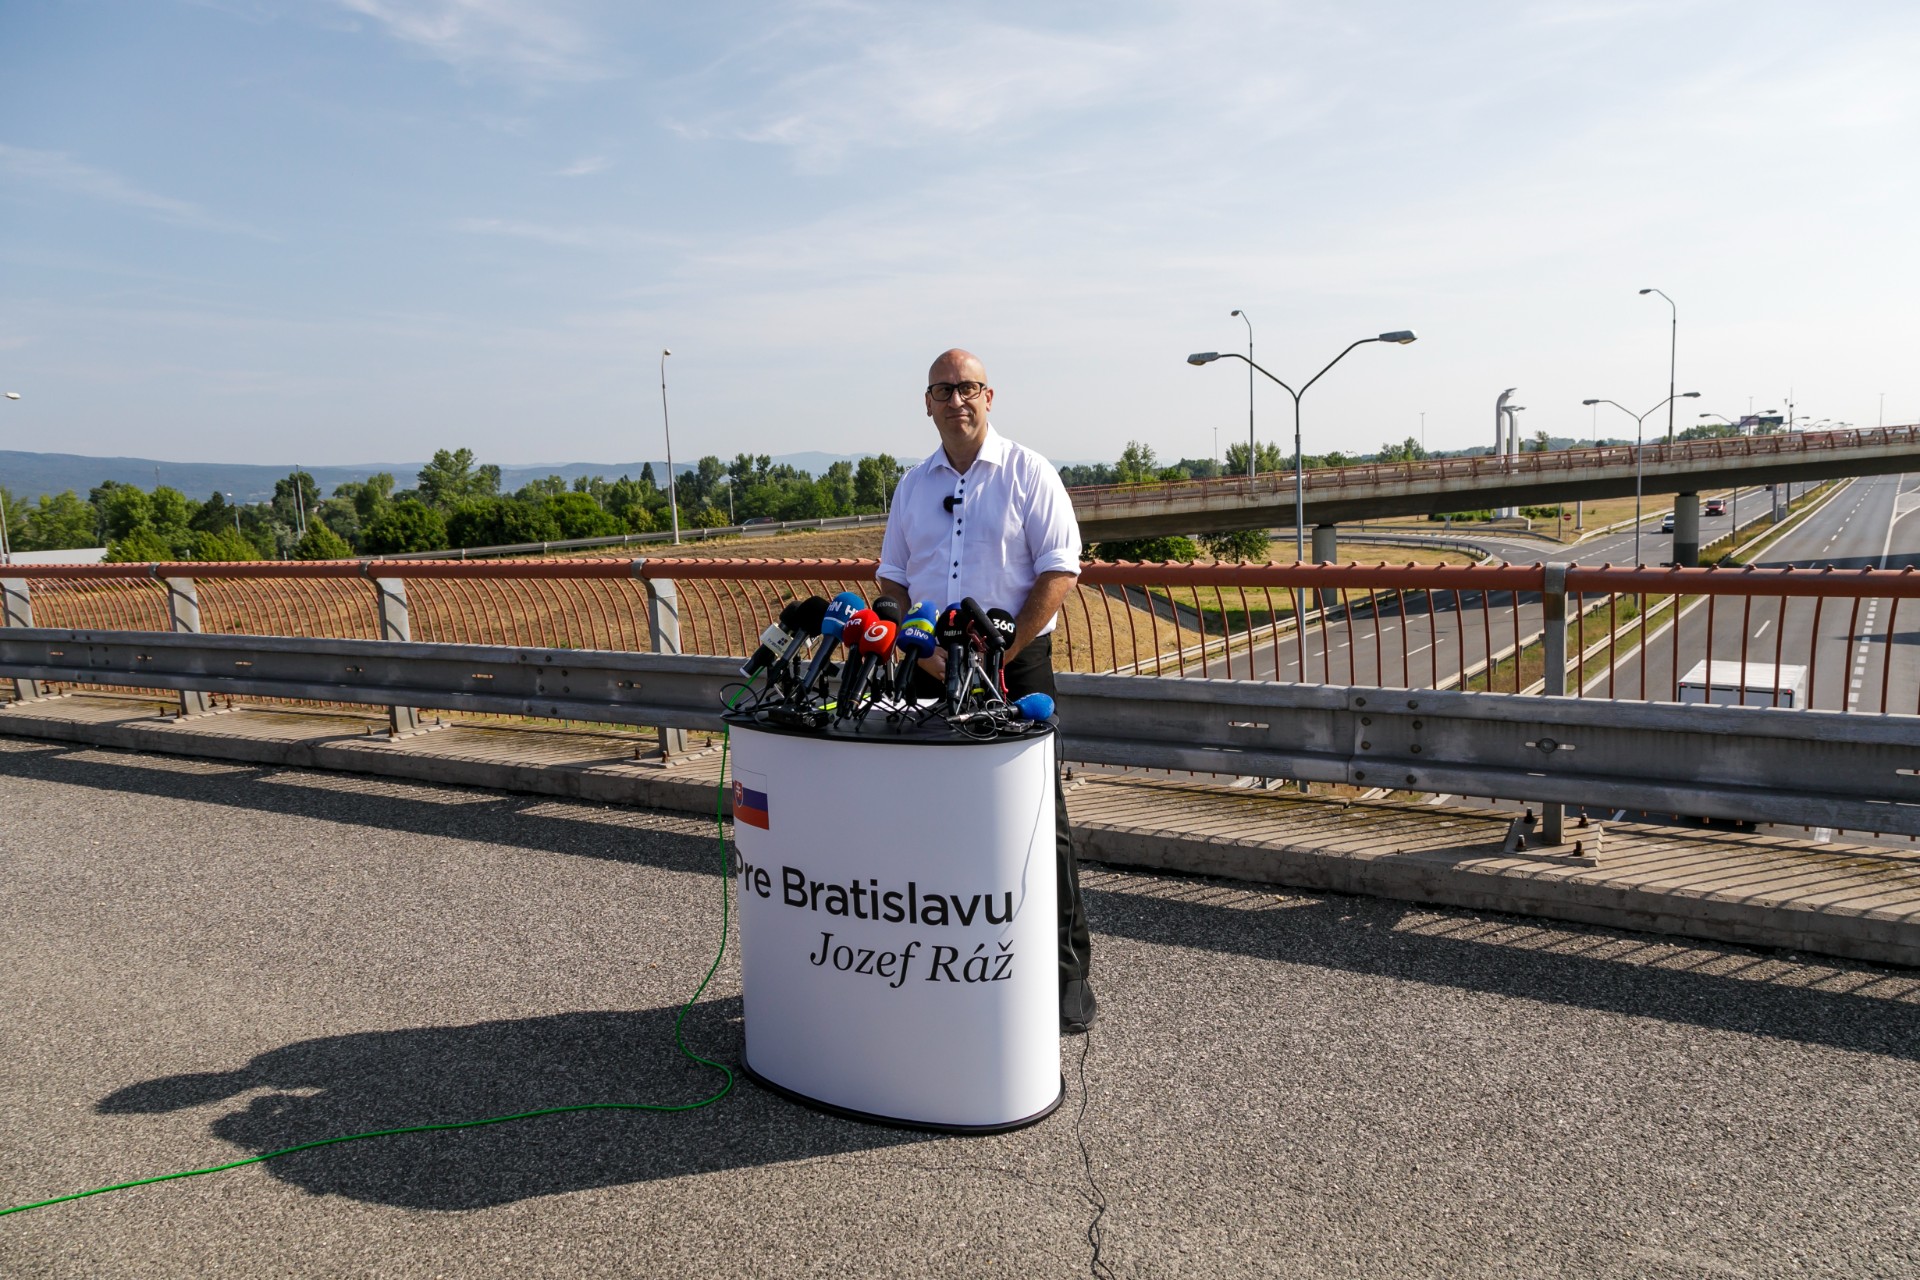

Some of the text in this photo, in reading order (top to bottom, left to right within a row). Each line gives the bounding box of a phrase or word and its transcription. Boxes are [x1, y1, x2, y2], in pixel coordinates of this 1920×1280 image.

[845, 605, 859, 618] H
[782, 866, 1012, 926] Bratislavu
[810, 932, 1014, 988] Jozef Ráž
